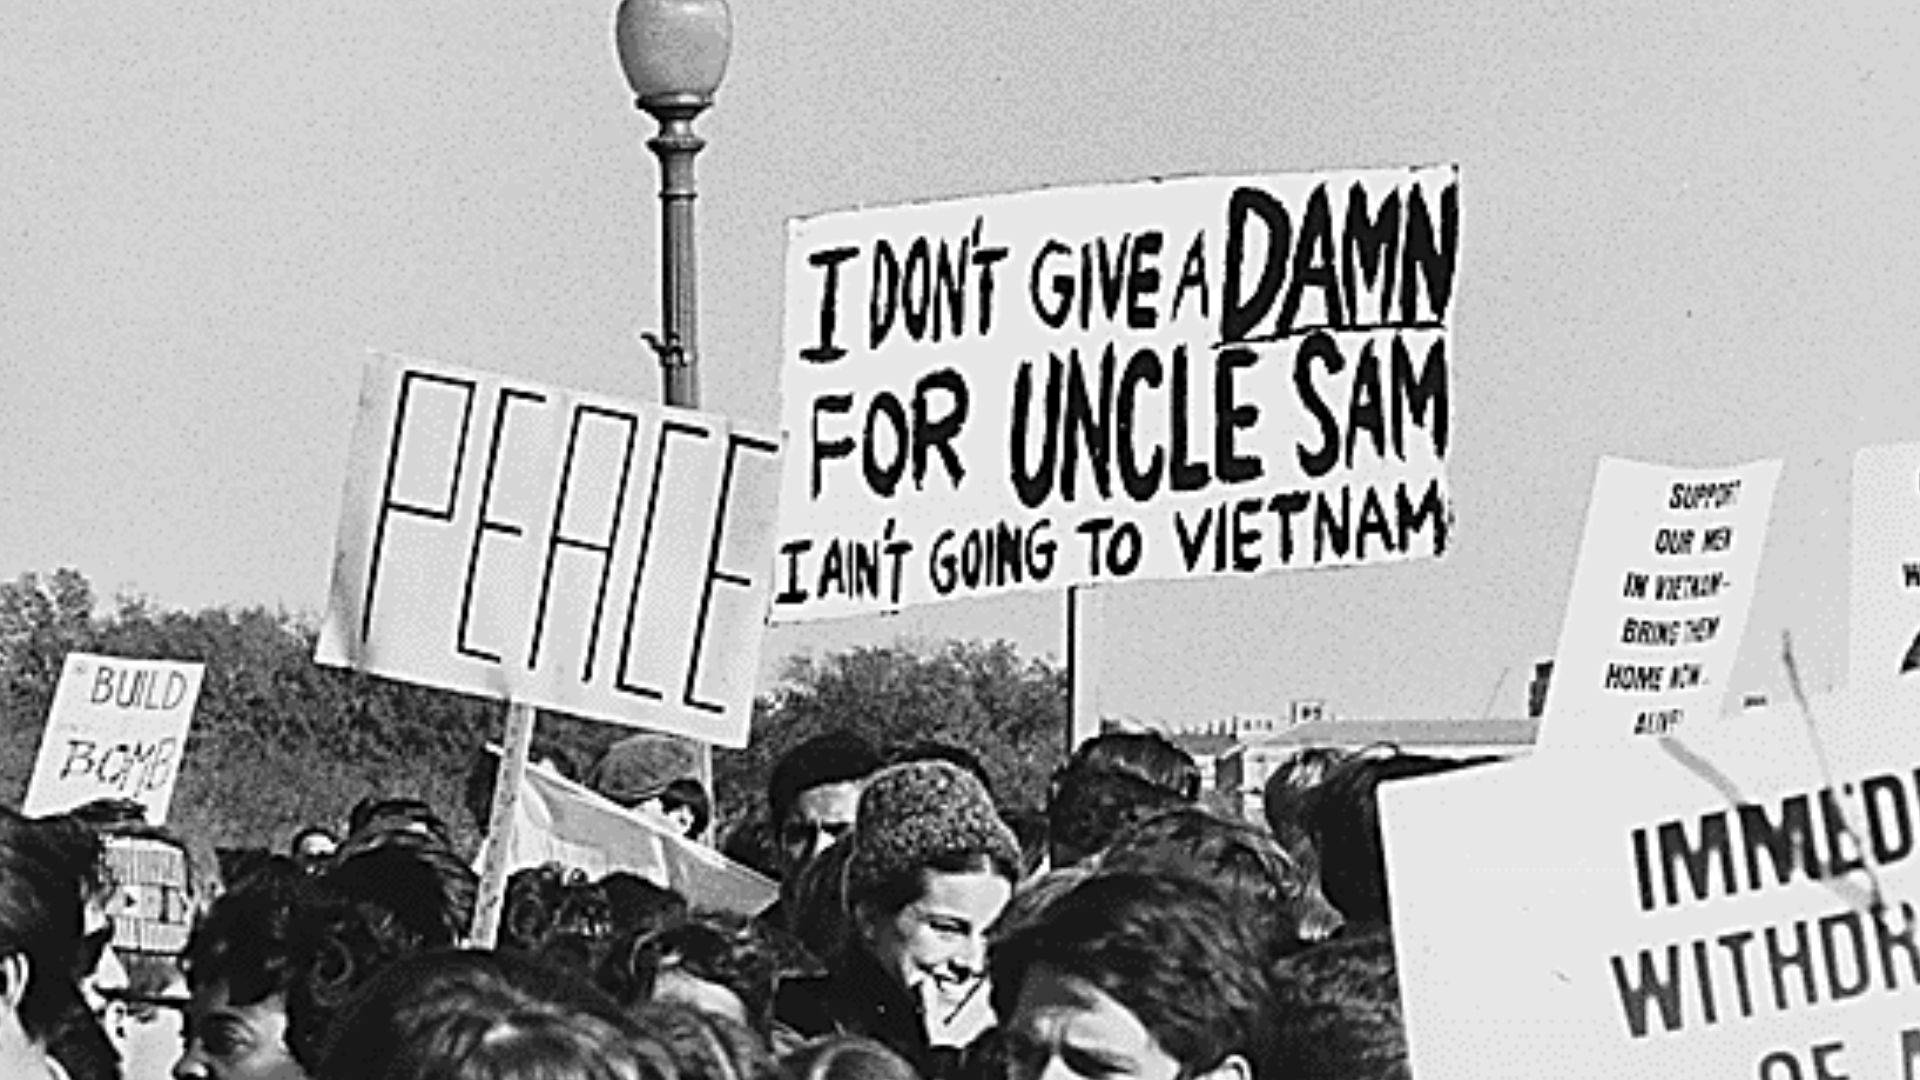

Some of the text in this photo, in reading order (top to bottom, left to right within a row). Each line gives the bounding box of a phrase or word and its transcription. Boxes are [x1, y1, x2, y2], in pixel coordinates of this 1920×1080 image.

[799, 181, 1459, 364] I DON'T GIVE A DAMN
[811, 329, 1449, 508] FOR UNCLE SAM
[362, 369, 778, 713] PEACE
[774, 478, 1448, 604] I AIN'T GOING TO VIETNAM
[90, 665, 188, 711] BUILD
